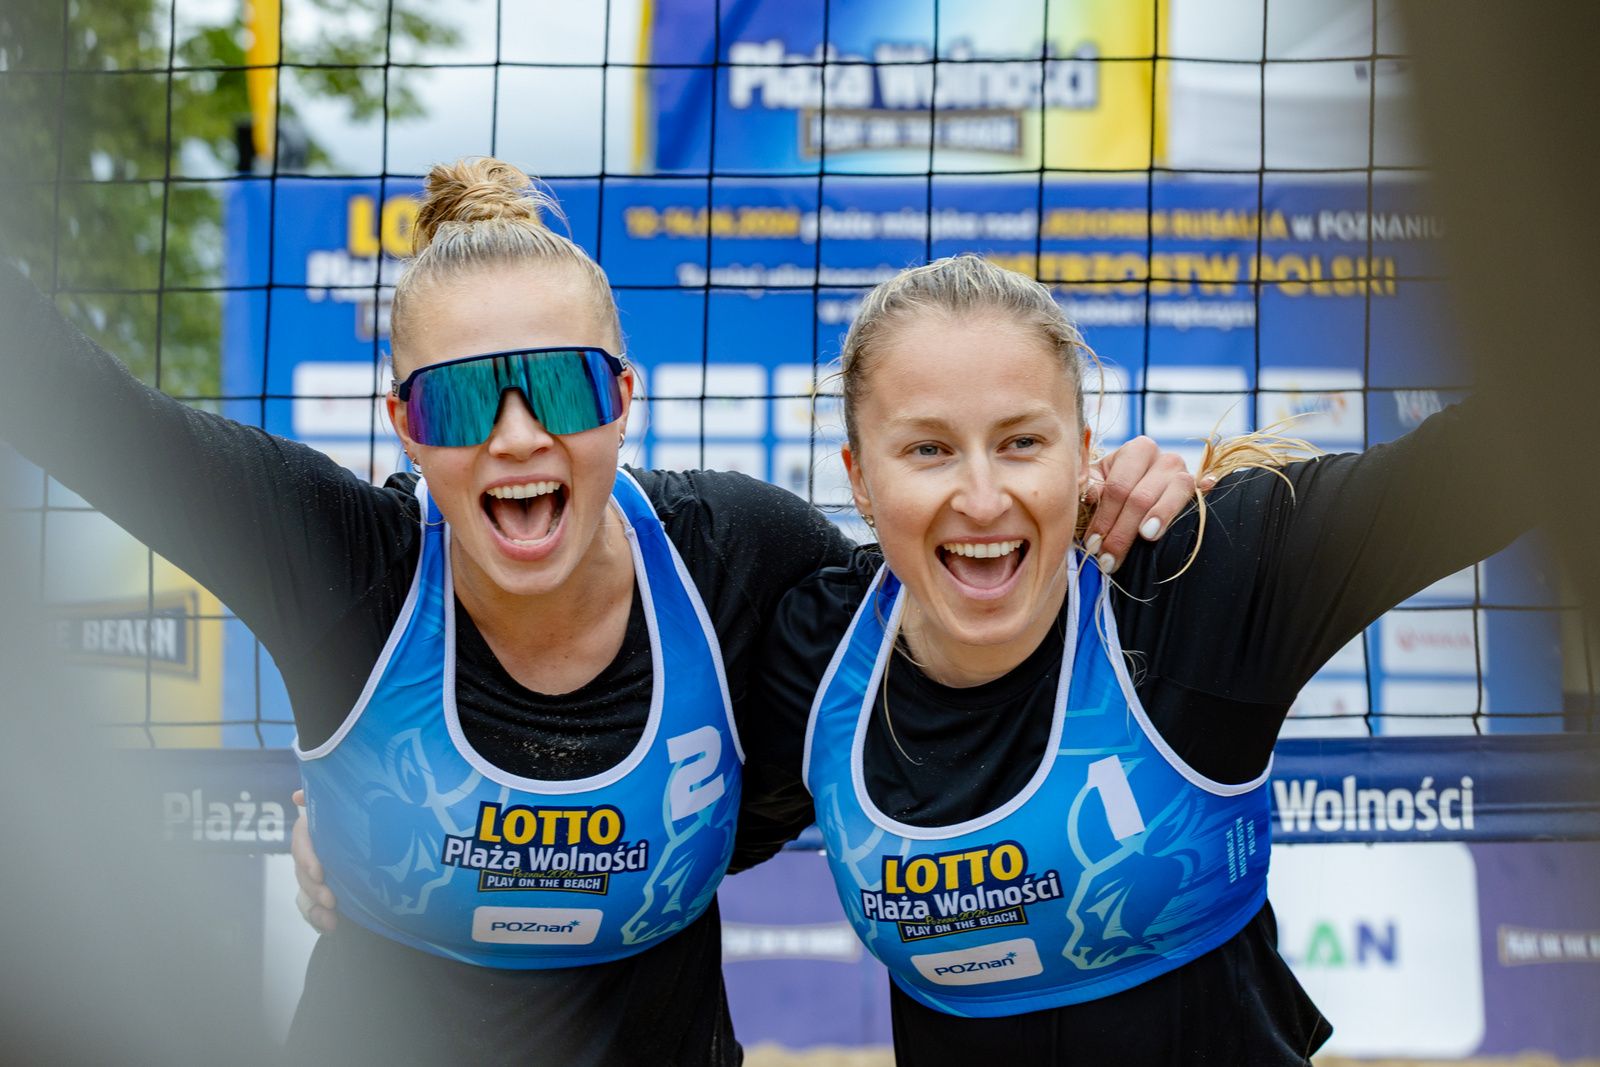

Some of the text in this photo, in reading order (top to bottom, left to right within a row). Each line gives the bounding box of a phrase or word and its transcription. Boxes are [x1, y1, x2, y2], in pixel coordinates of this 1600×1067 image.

[666, 725, 726, 822] 2
[1087, 754, 1147, 841] 1
[162, 788, 285, 842] Plaża
[1273, 775, 1475, 833] Wolności
[478, 805, 621, 846] LOTTO
[444, 837, 646, 873] Plaża Wolności
[885, 844, 1024, 895] LOTTO
[486, 875, 601, 890] PLAY ON THE BEACH
[863, 871, 1061, 921] Plaża Wolności
[905, 911, 1018, 937] PLAY ON THE BEACH
